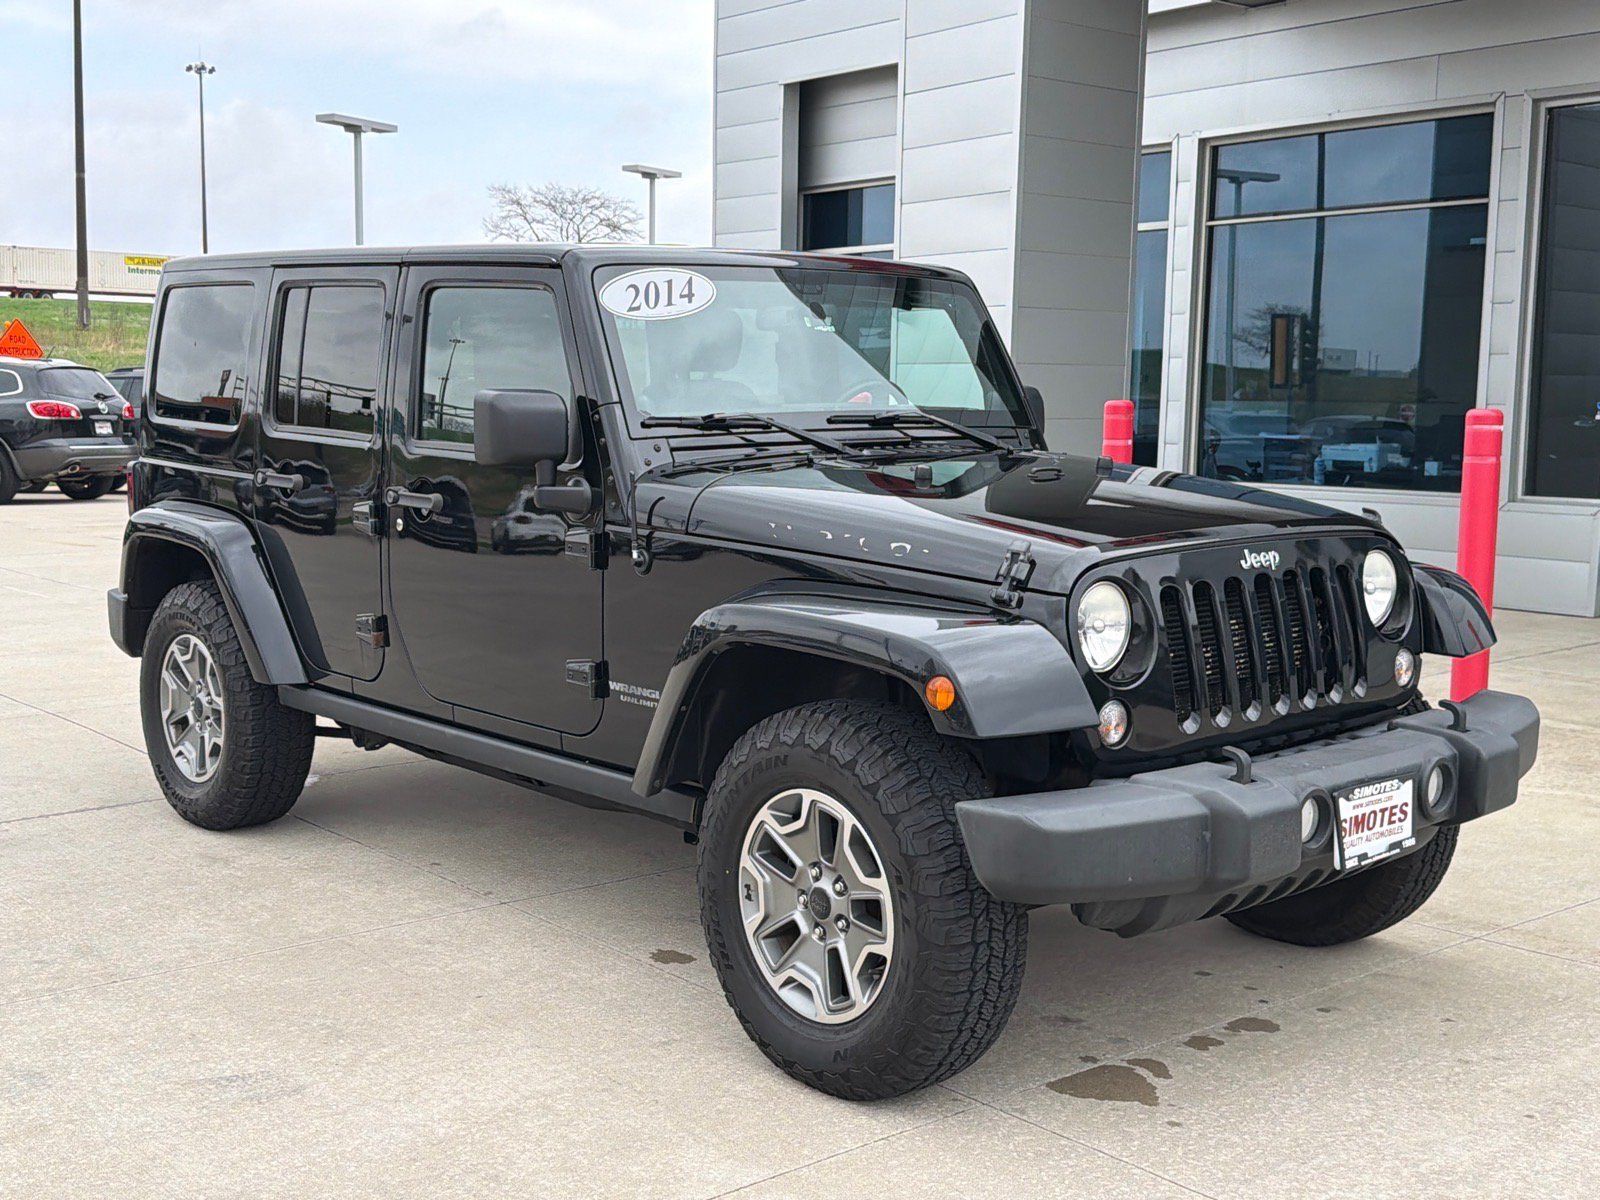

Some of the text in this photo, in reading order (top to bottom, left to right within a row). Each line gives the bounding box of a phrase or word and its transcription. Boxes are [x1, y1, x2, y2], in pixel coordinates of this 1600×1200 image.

[624, 276, 695, 313] 2014
[9, 335, 26, 344] ROAD
[1240, 548, 1280, 571] Jeep
[1353, 779, 1399, 800] SIMOTES
[1341, 802, 1408, 838] SIMOTES
[1364, 825, 1404, 842] AUTOMOBILES
